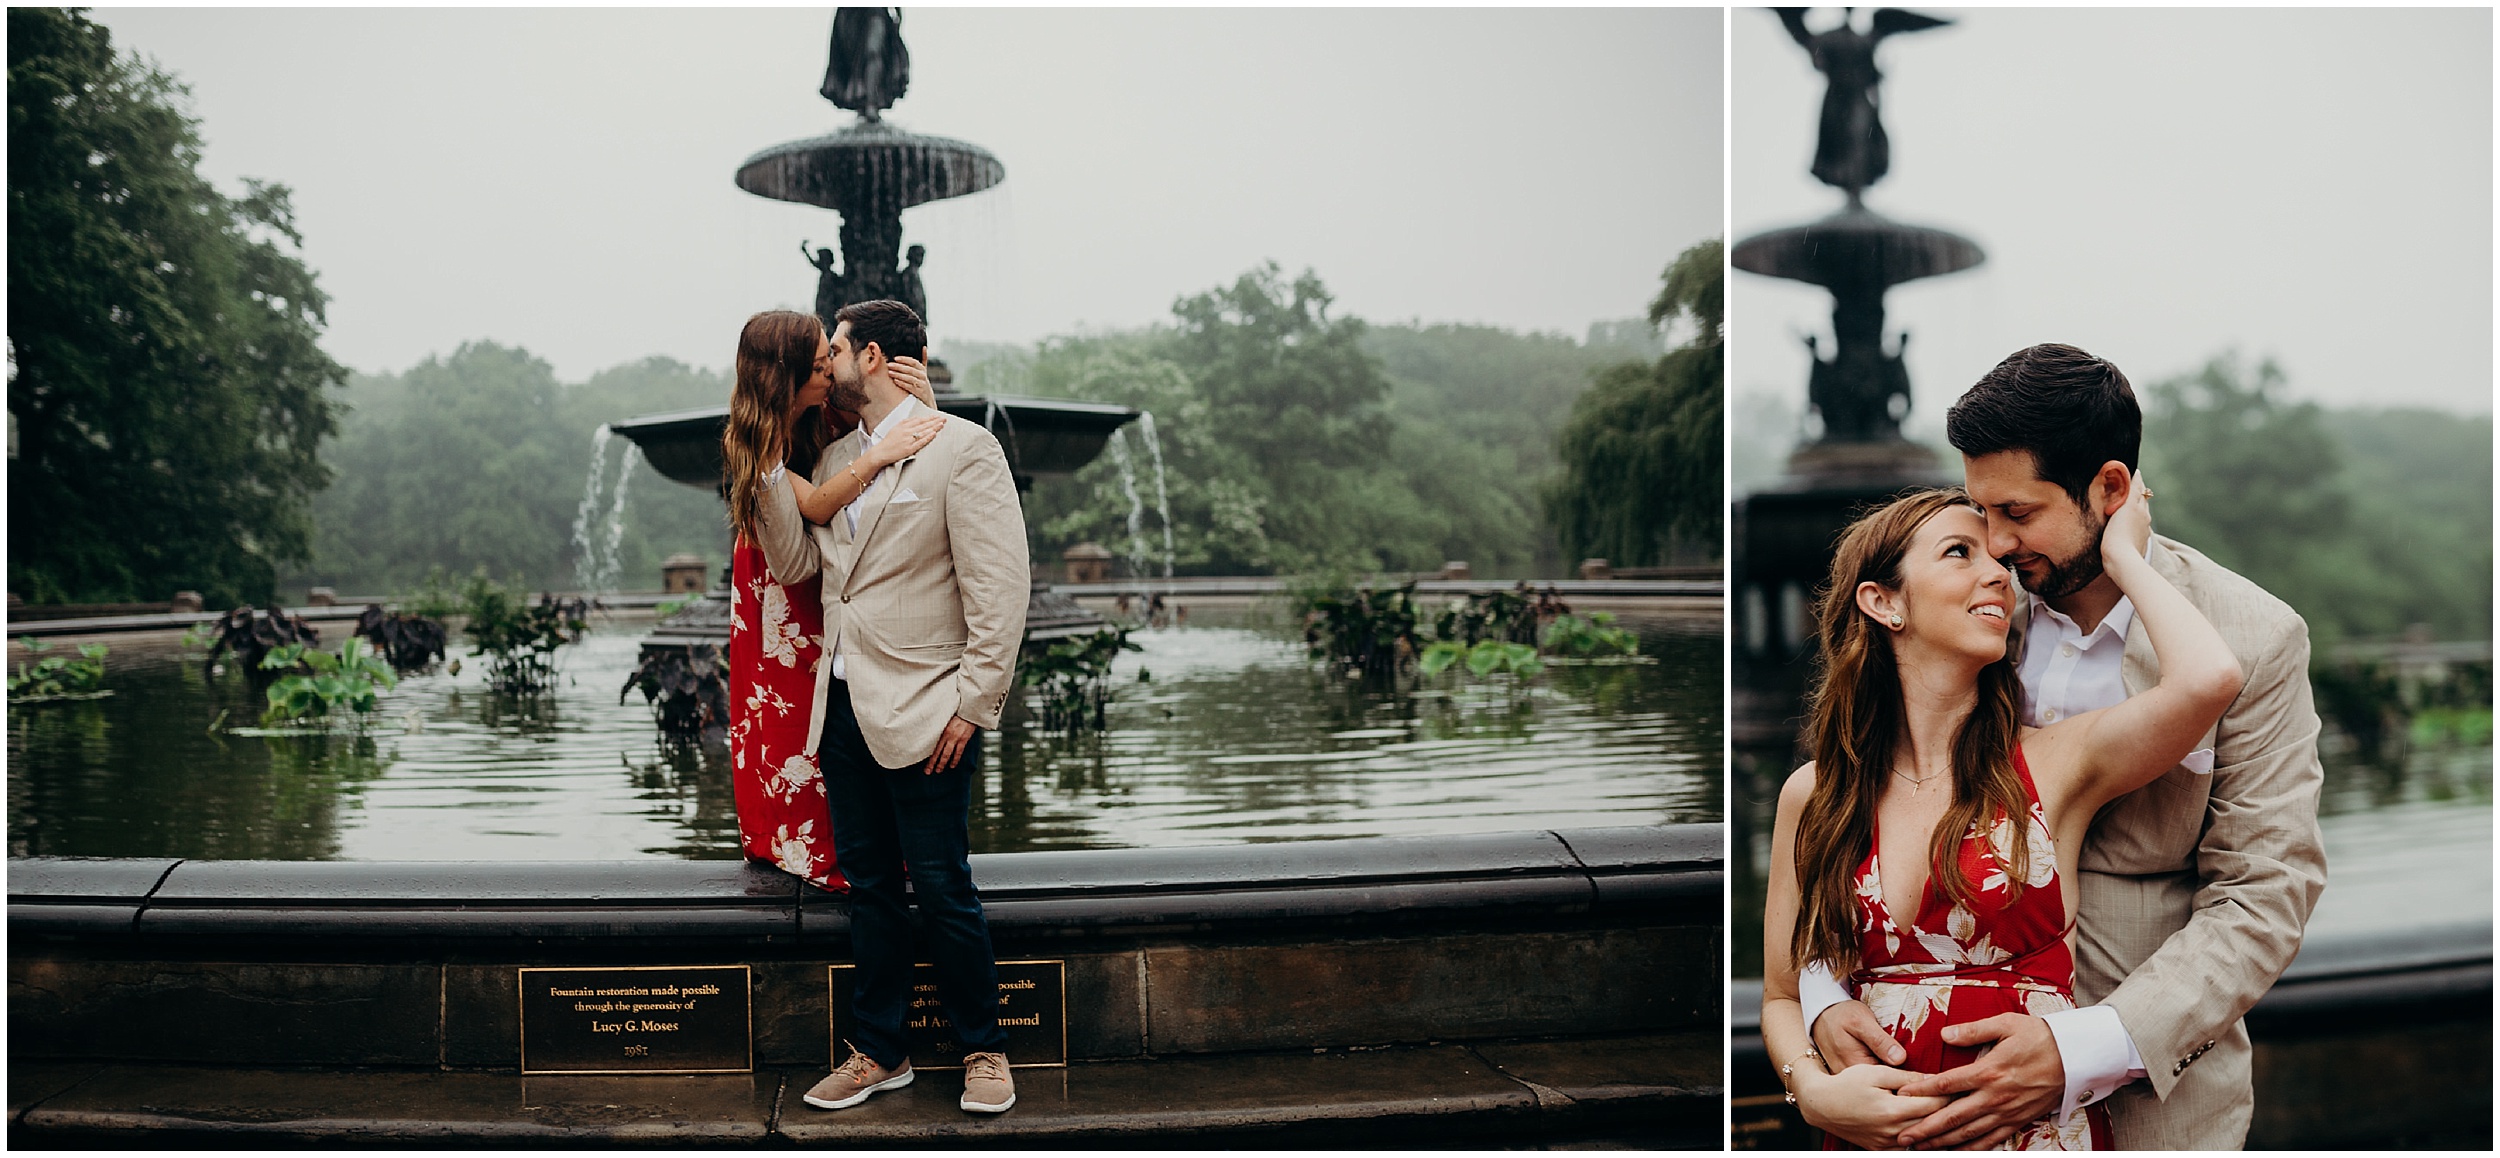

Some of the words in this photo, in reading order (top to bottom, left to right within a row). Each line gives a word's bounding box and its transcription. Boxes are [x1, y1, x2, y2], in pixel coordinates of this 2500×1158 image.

[550, 987, 594, 996] Fountain
[596, 986, 649, 996] restoration
[651, 985, 679, 996] made
[682, 984, 720, 998] possible
[998, 979, 1036, 992] possible
[574, 1001, 613, 1013] through
[615, 1000, 631, 1011] the
[632, 1000, 682, 1012] generosity
[684, 999, 697, 1010] of
[998, 994, 1010, 1005] of
[592, 1020, 623, 1035] Lucy
[624, 1020, 639, 1032] G.
[641, 1020, 679, 1032] Moses
